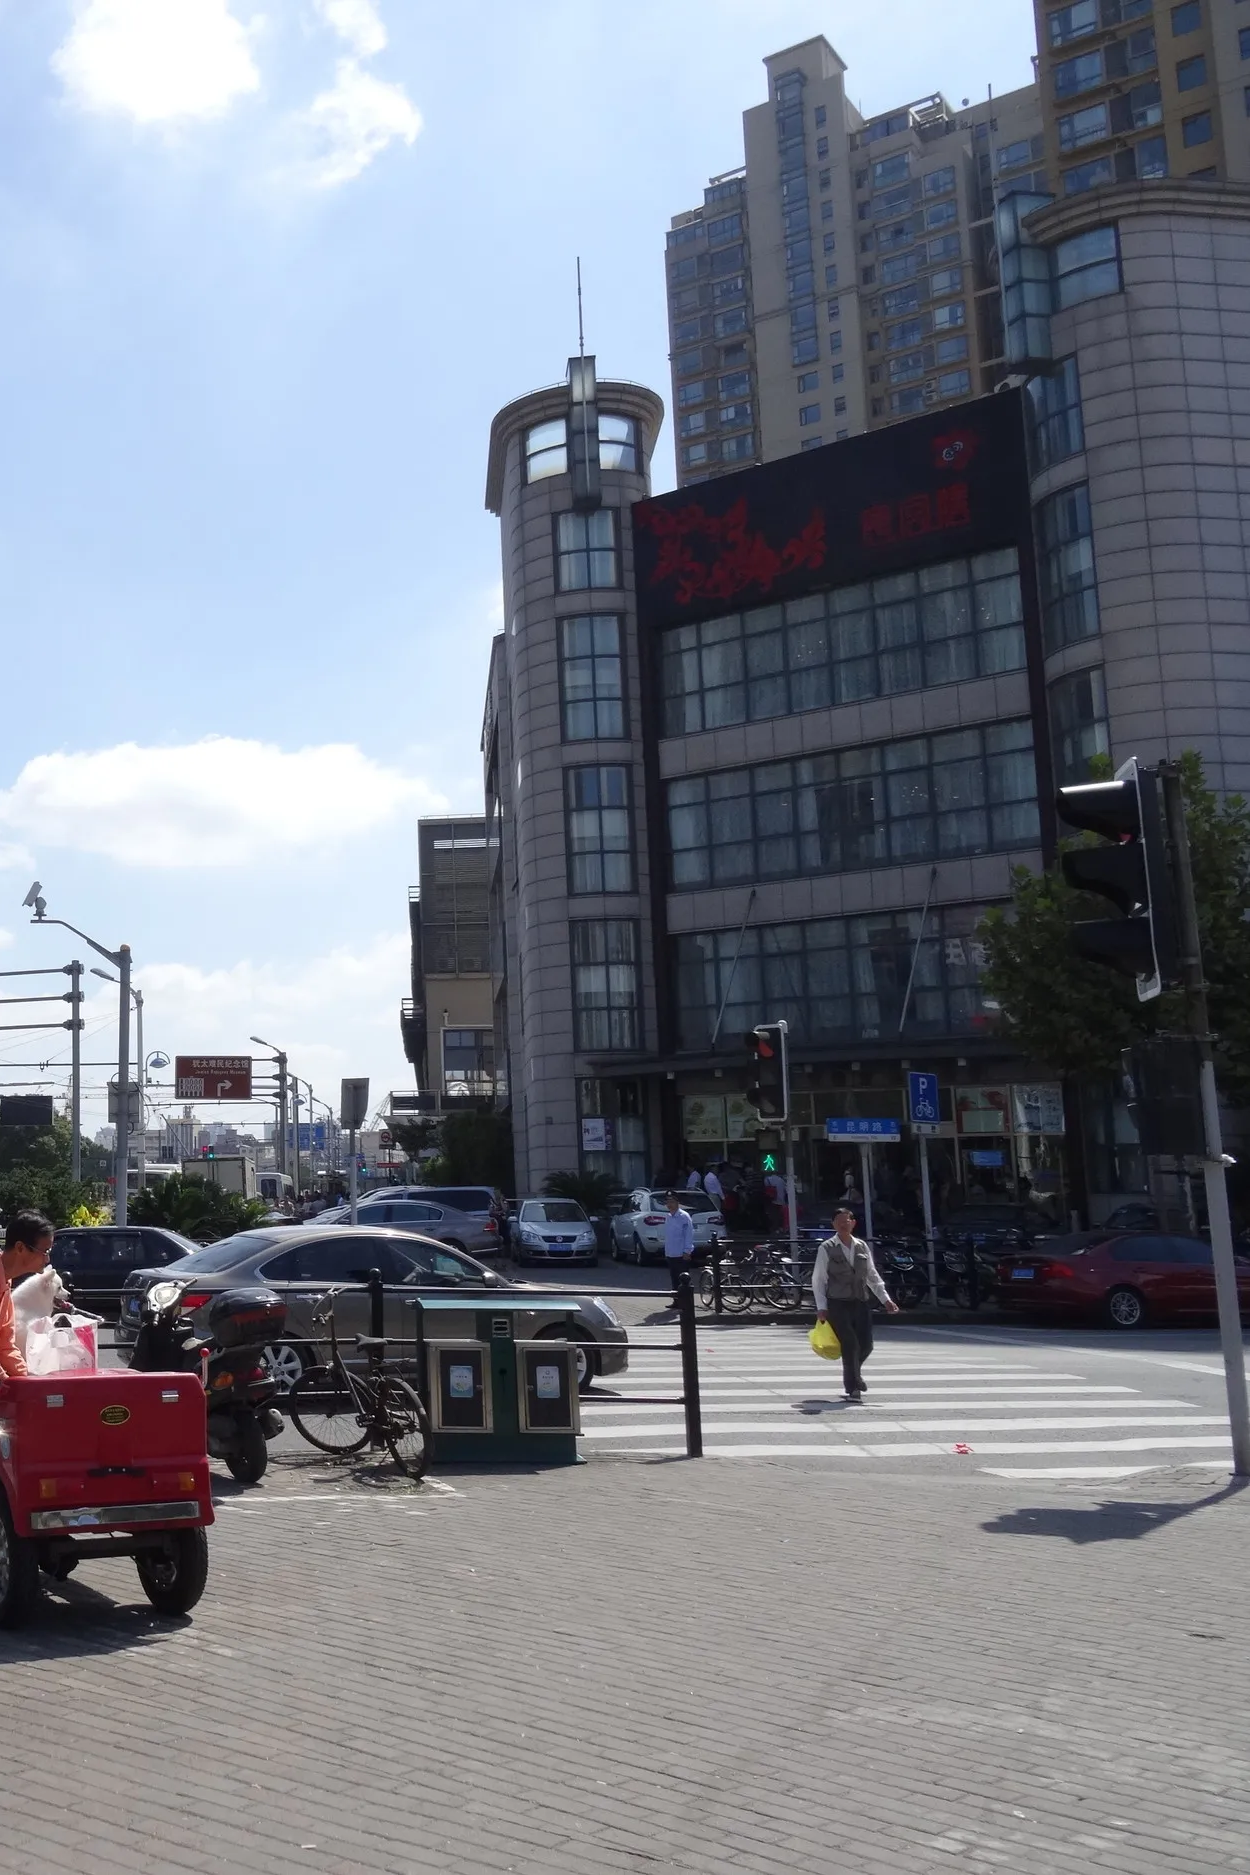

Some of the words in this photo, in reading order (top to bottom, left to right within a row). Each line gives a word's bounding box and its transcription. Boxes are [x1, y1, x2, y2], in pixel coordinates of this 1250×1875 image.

[918, 1077, 928, 1095] P
[846, 1120, 883, 1132] 昆明路
